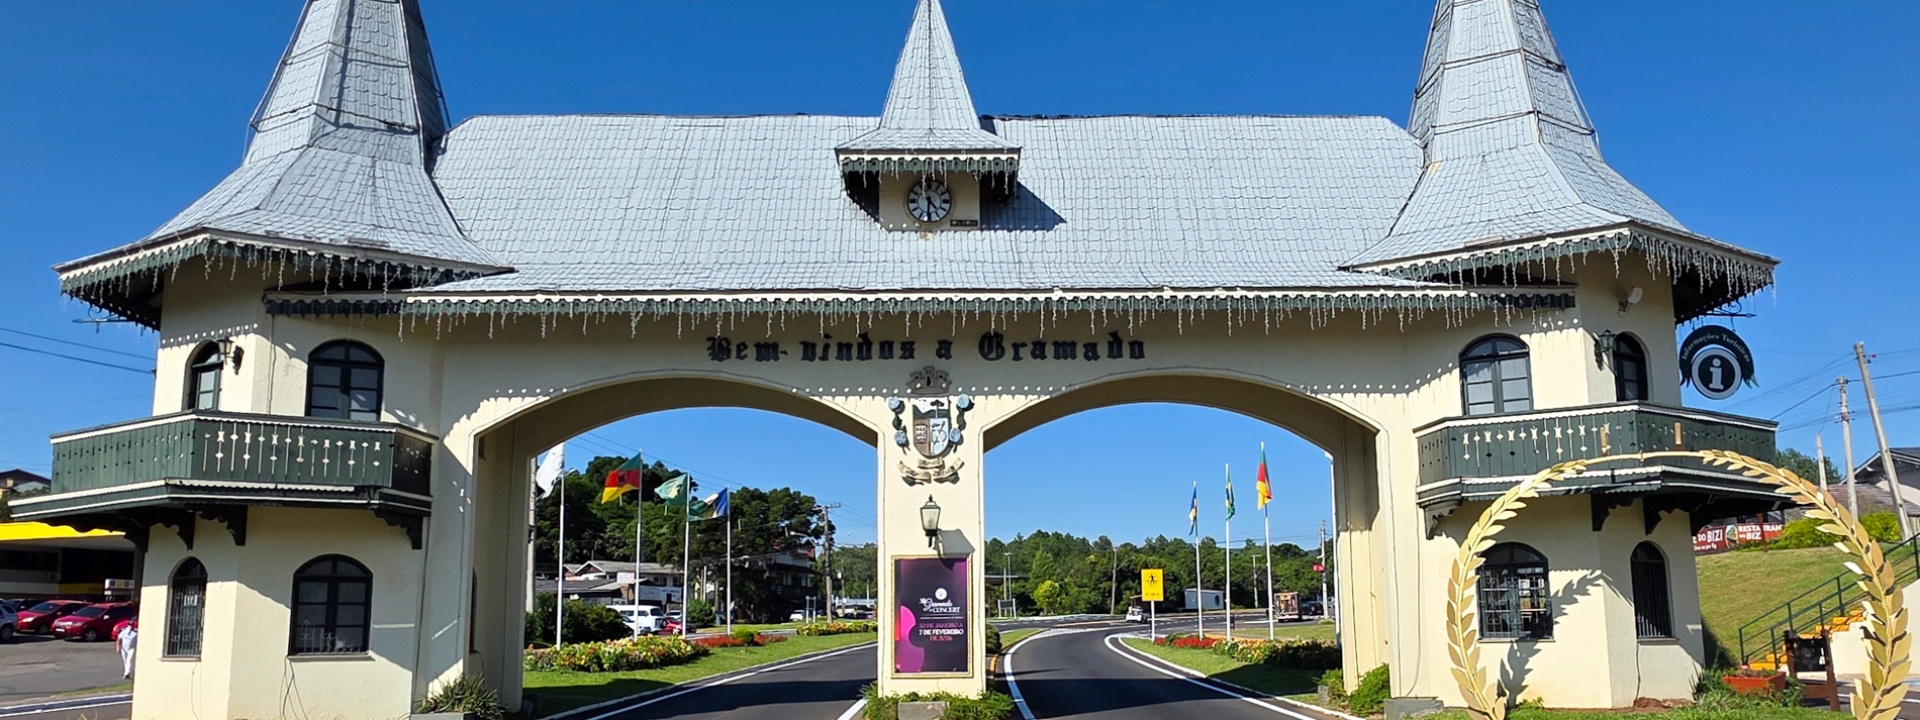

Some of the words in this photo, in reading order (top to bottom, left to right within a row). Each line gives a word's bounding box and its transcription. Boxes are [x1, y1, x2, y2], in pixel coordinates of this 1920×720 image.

[799, 332, 916, 362] vindos
[936, 339, 953, 361] a
[978, 330, 1146, 362] Gramado
[1681, 332, 1720, 360] Informações
[1697, 533, 1706, 542] DO
[1707, 529, 1723, 543] BIZI
[1746, 532, 1762, 540] BIZ
